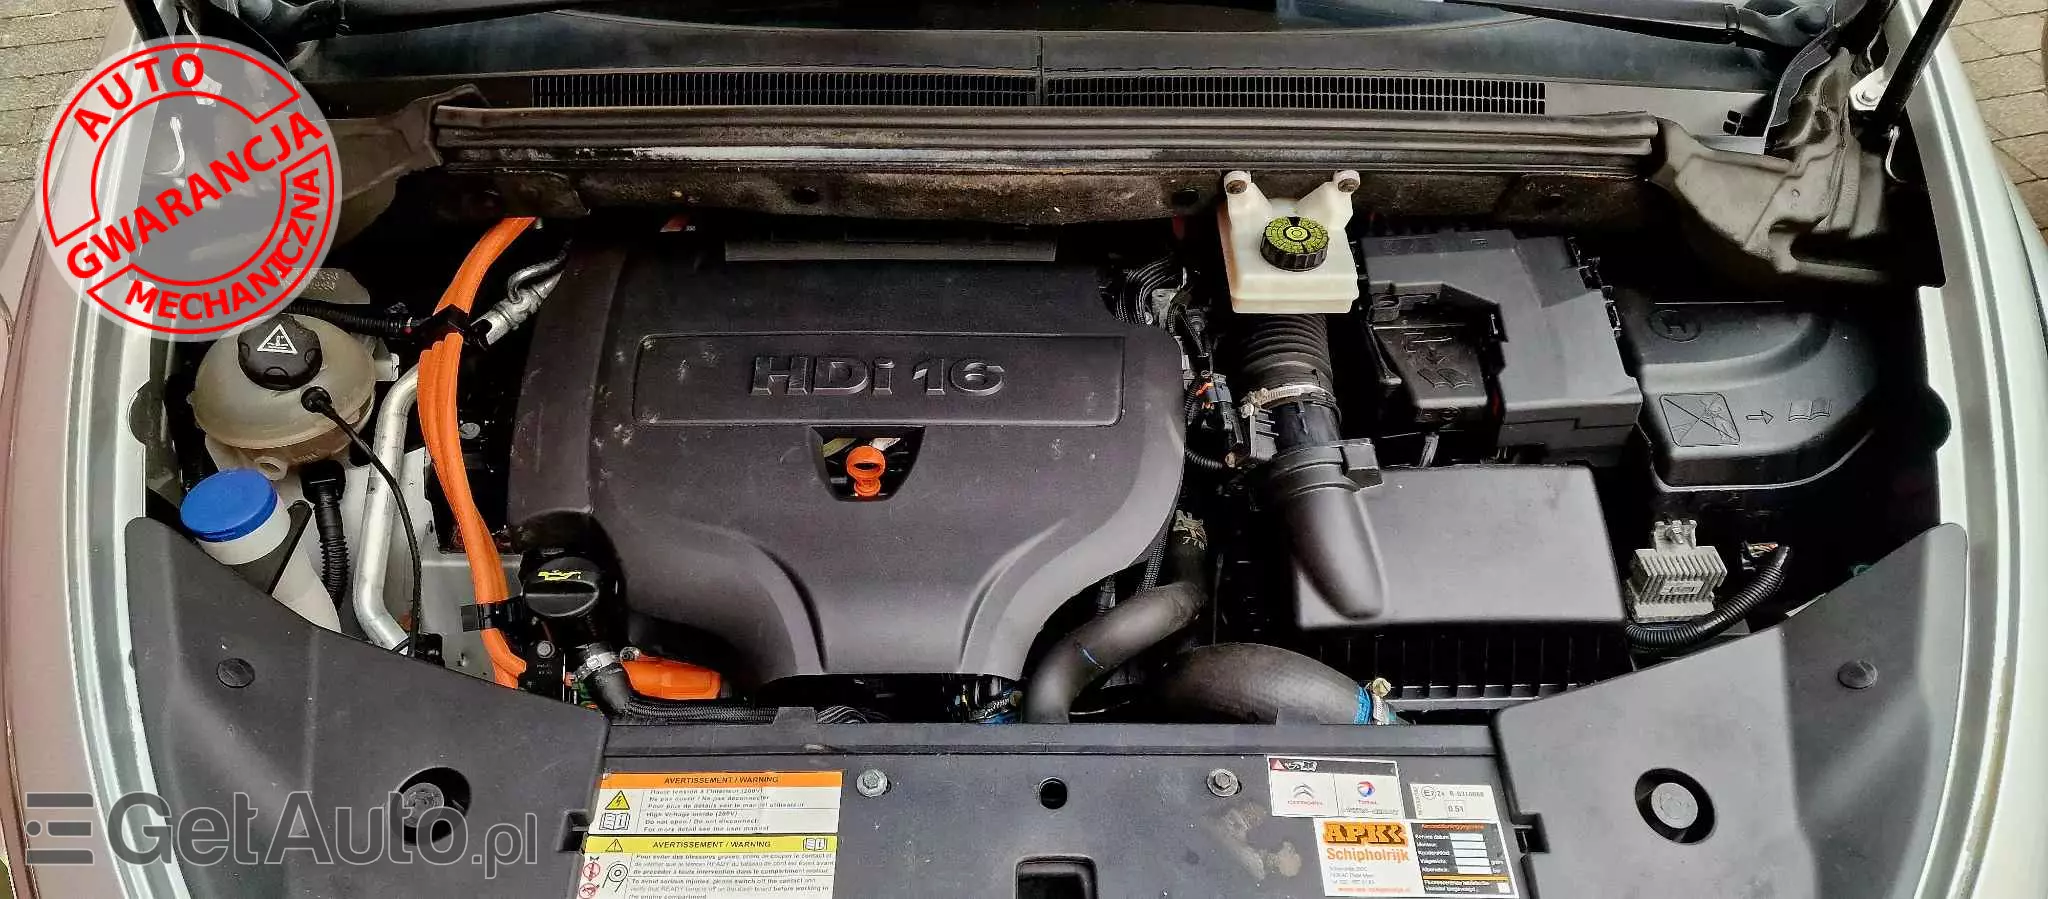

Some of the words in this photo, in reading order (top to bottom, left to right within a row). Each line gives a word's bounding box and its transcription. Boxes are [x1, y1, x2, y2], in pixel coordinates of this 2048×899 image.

[748, 355, 897, 397] HDi
[911, 356, 1005, 397] 16
[1326, 848, 1408, 864] Schipholrijk
